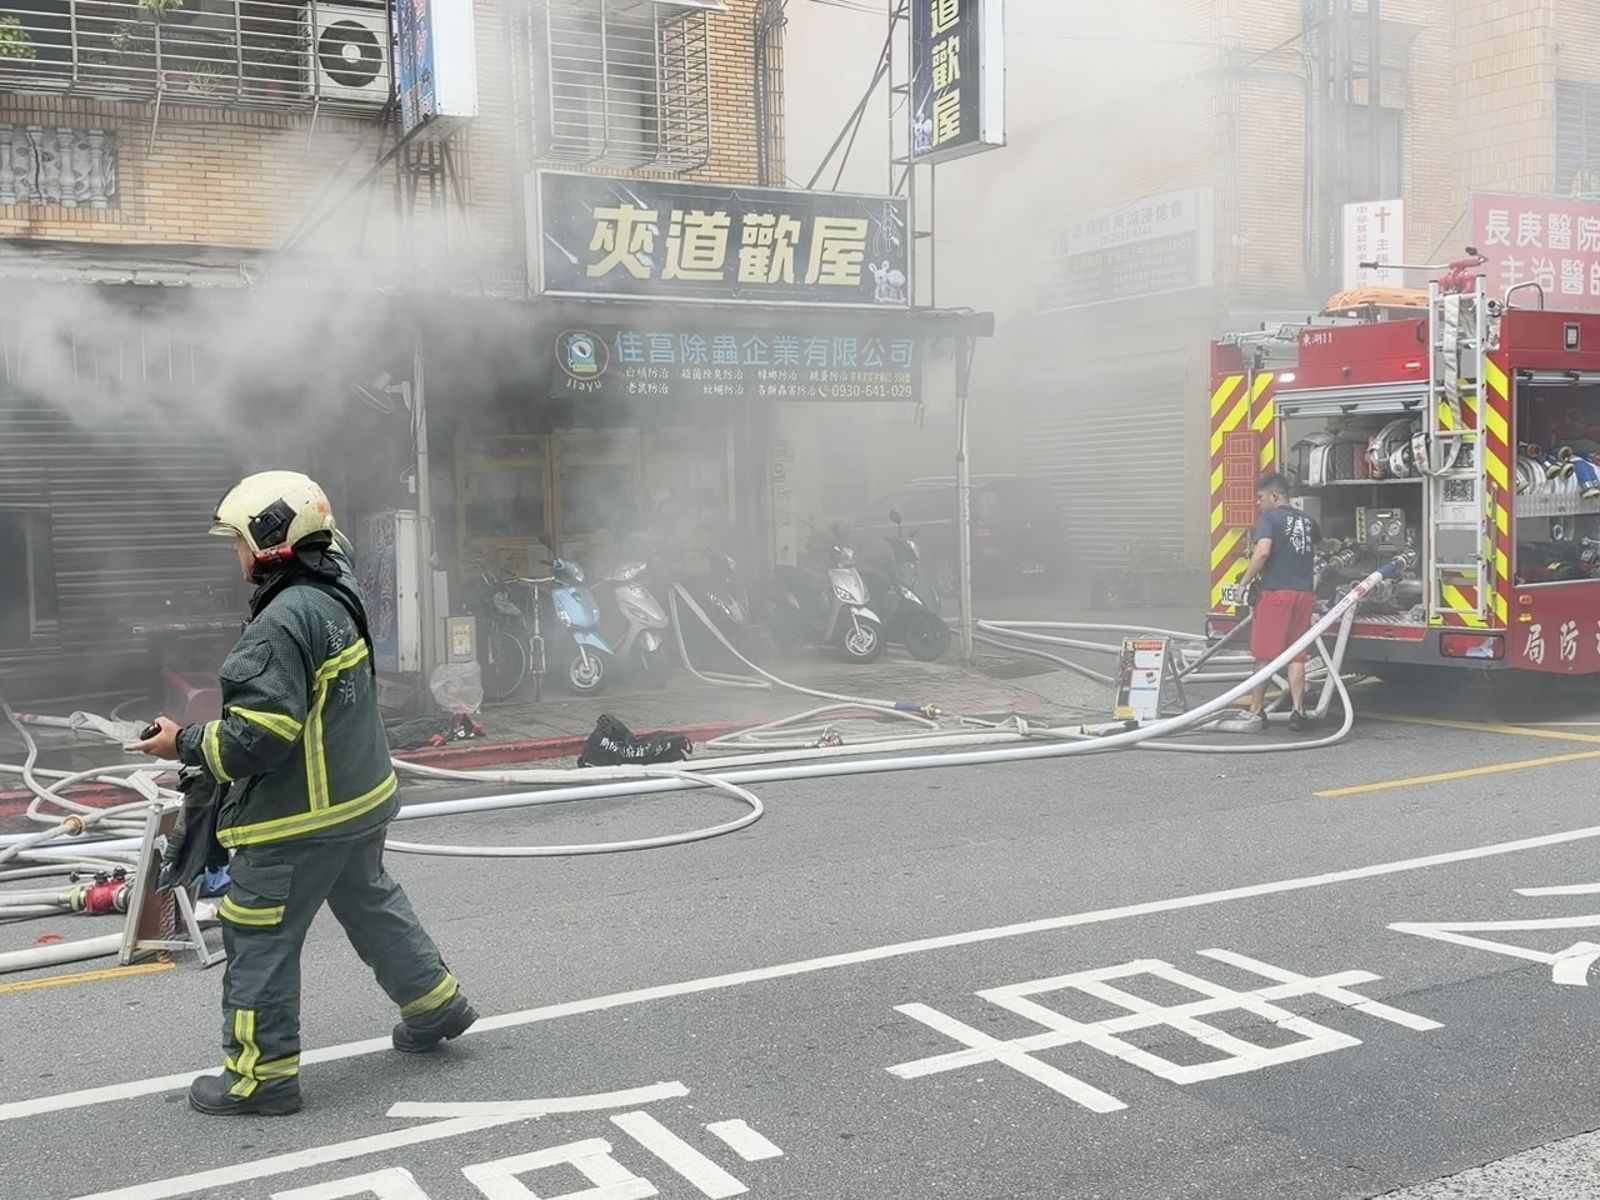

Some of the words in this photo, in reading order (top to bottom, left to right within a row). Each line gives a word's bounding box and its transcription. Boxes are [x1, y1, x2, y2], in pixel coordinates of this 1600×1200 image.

[586, 203, 871, 287] 夾道歡屋
[1484, 208, 1600, 254] 長庚醫院
[831, 383, 913, 398] 0930-641-029
